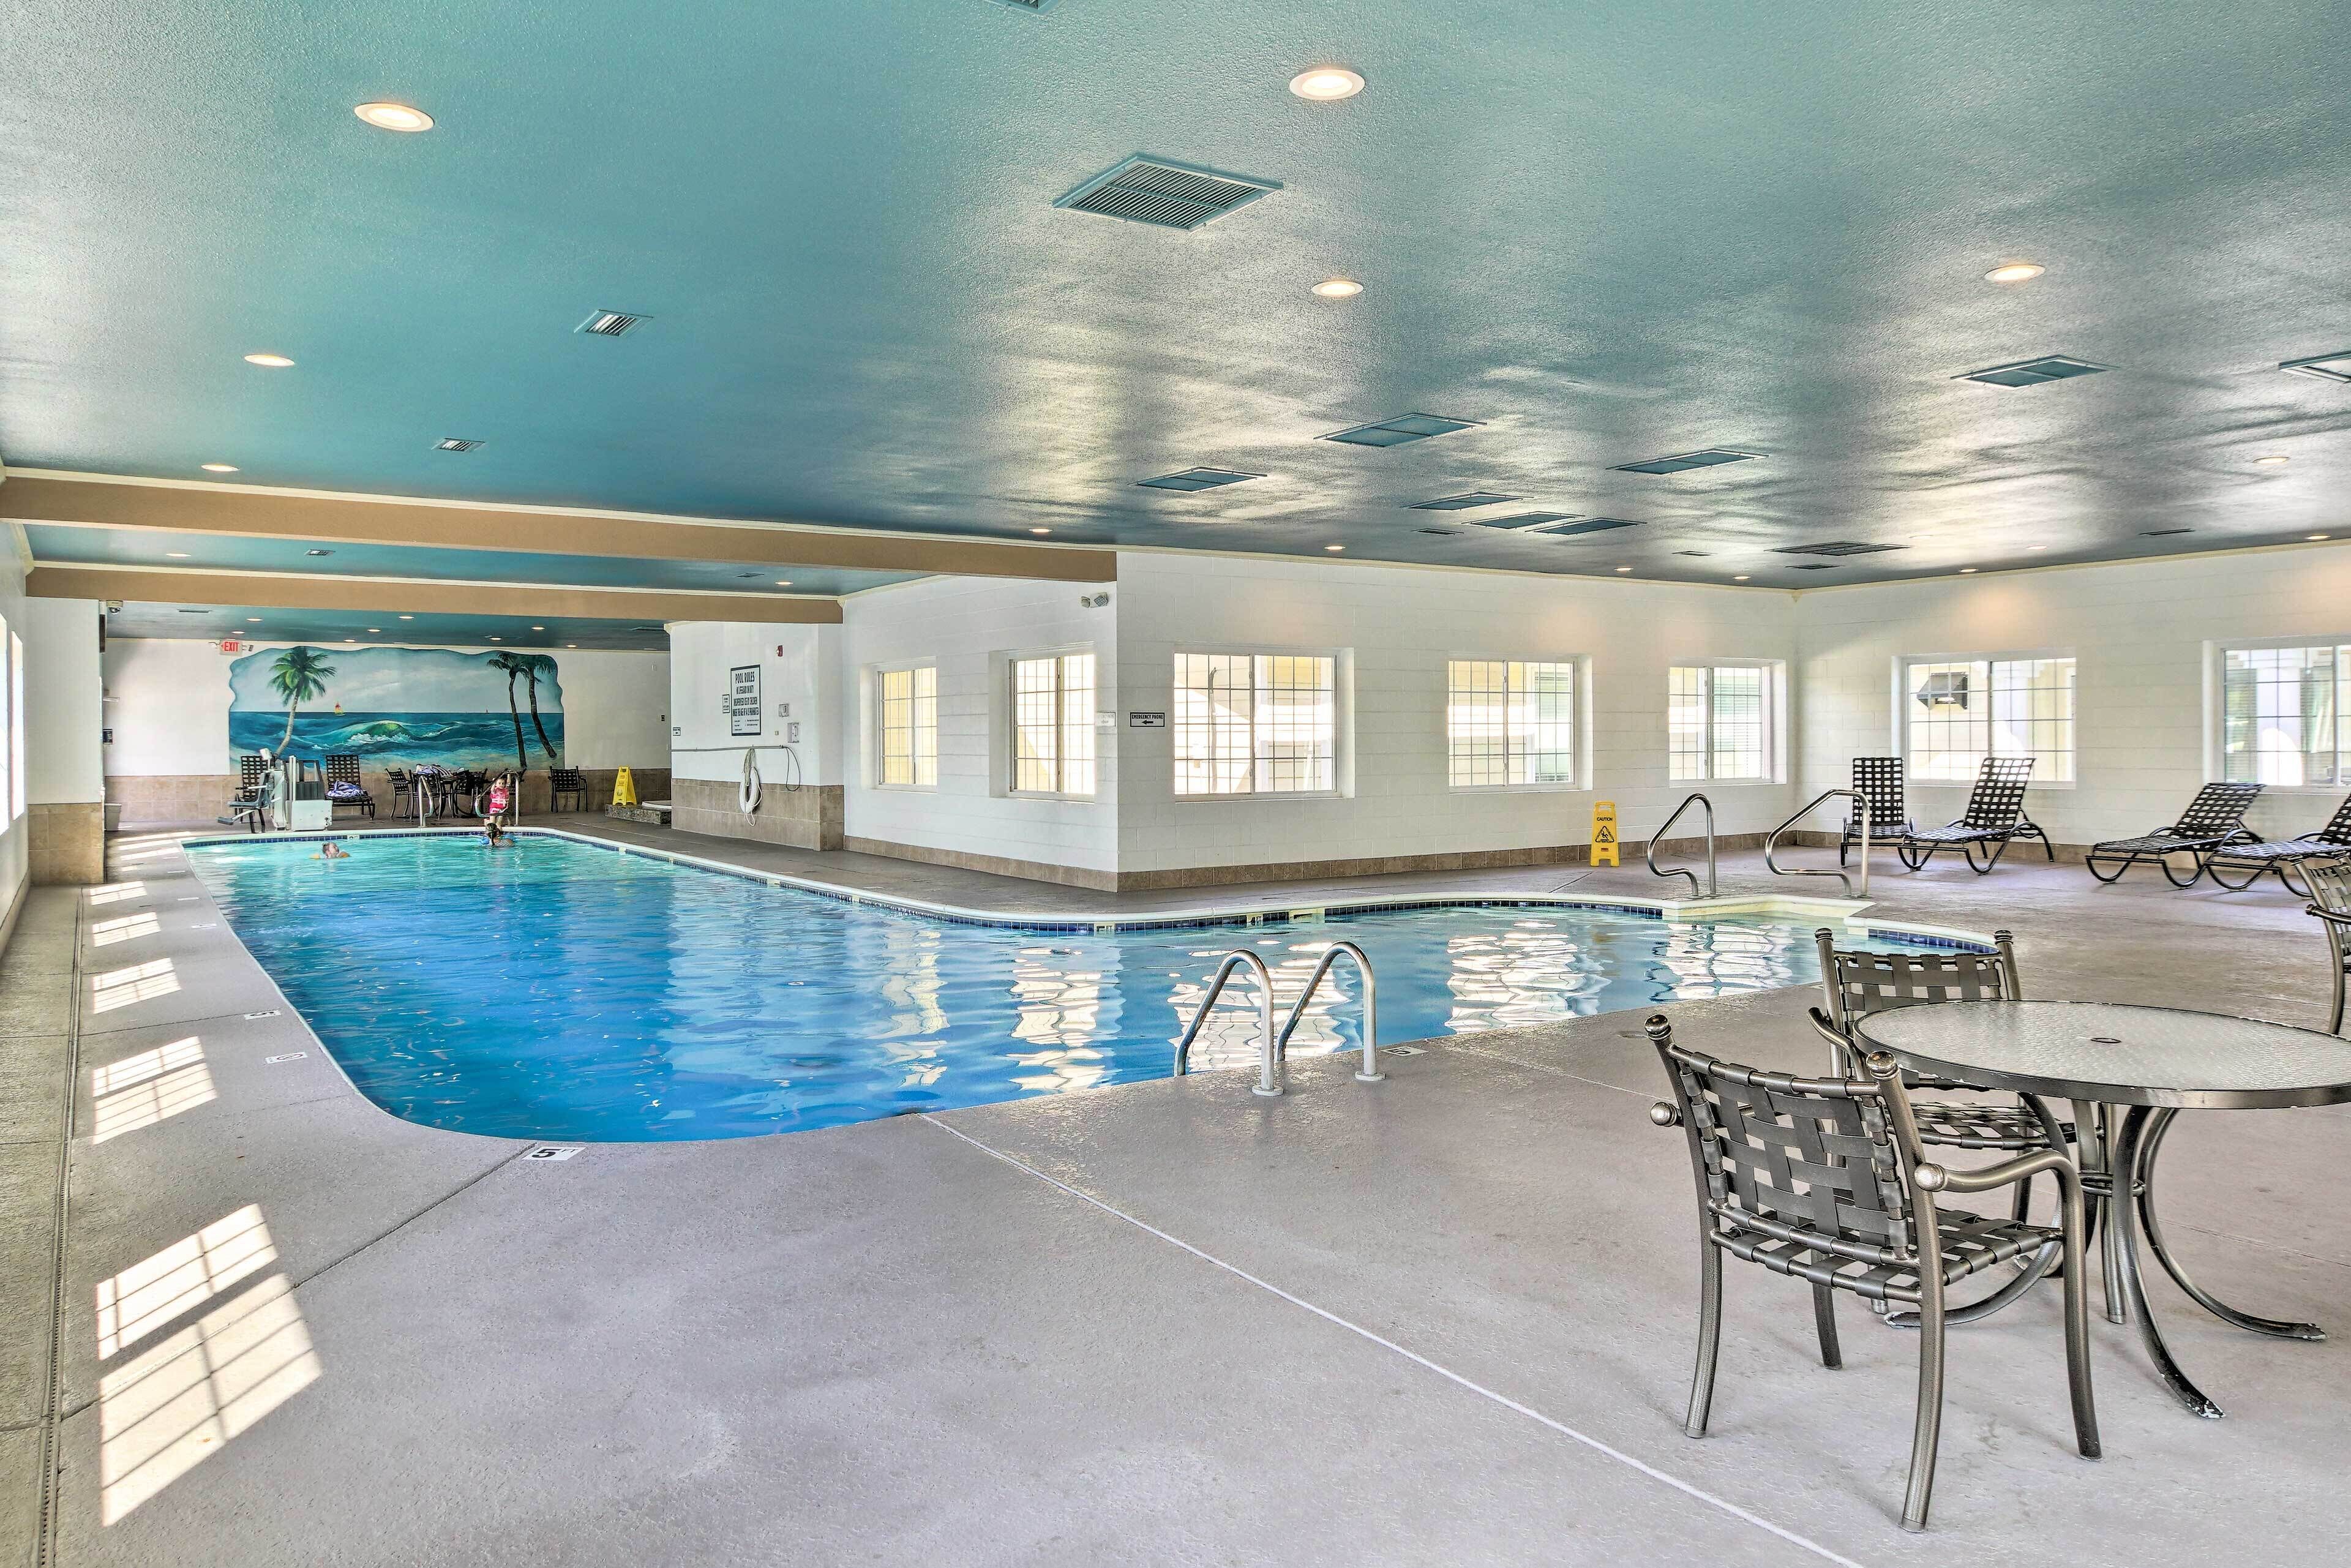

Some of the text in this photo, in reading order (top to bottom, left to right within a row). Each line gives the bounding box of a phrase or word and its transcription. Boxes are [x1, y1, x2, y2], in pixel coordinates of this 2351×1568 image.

[224, 641, 239, 651] EXIT
[735, 671, 755, 684] POOL RULES
[531, 1149, 561, 1158] 5
